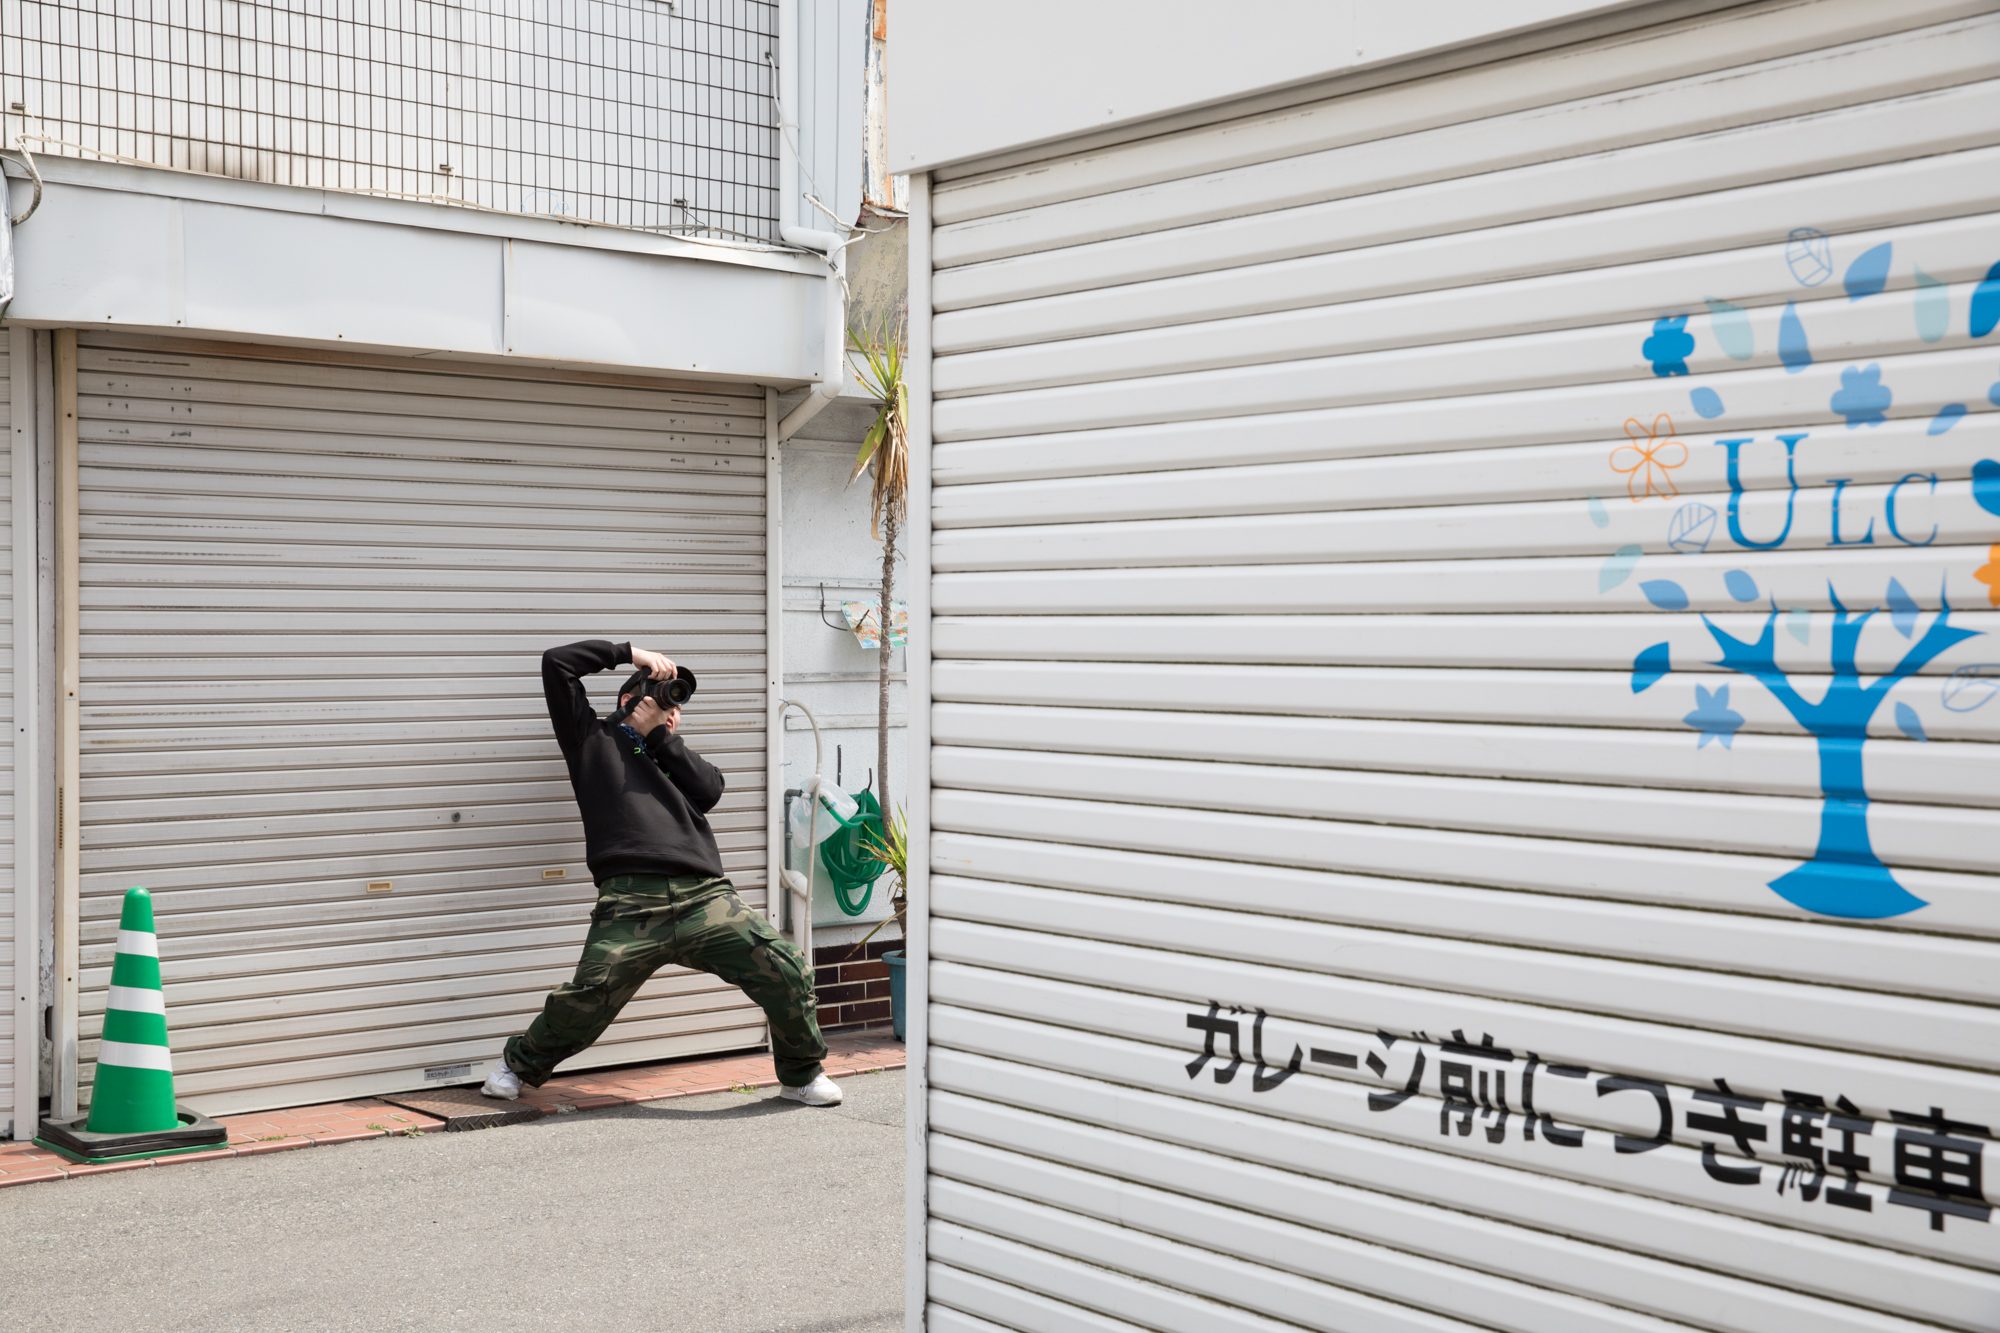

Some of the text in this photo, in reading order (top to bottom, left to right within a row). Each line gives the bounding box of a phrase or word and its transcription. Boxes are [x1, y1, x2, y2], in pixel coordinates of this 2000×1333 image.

[1713, 433, 1939, 550] ULC
[1185, 1000, 1992, 1232] ガレージ前につき駐車
